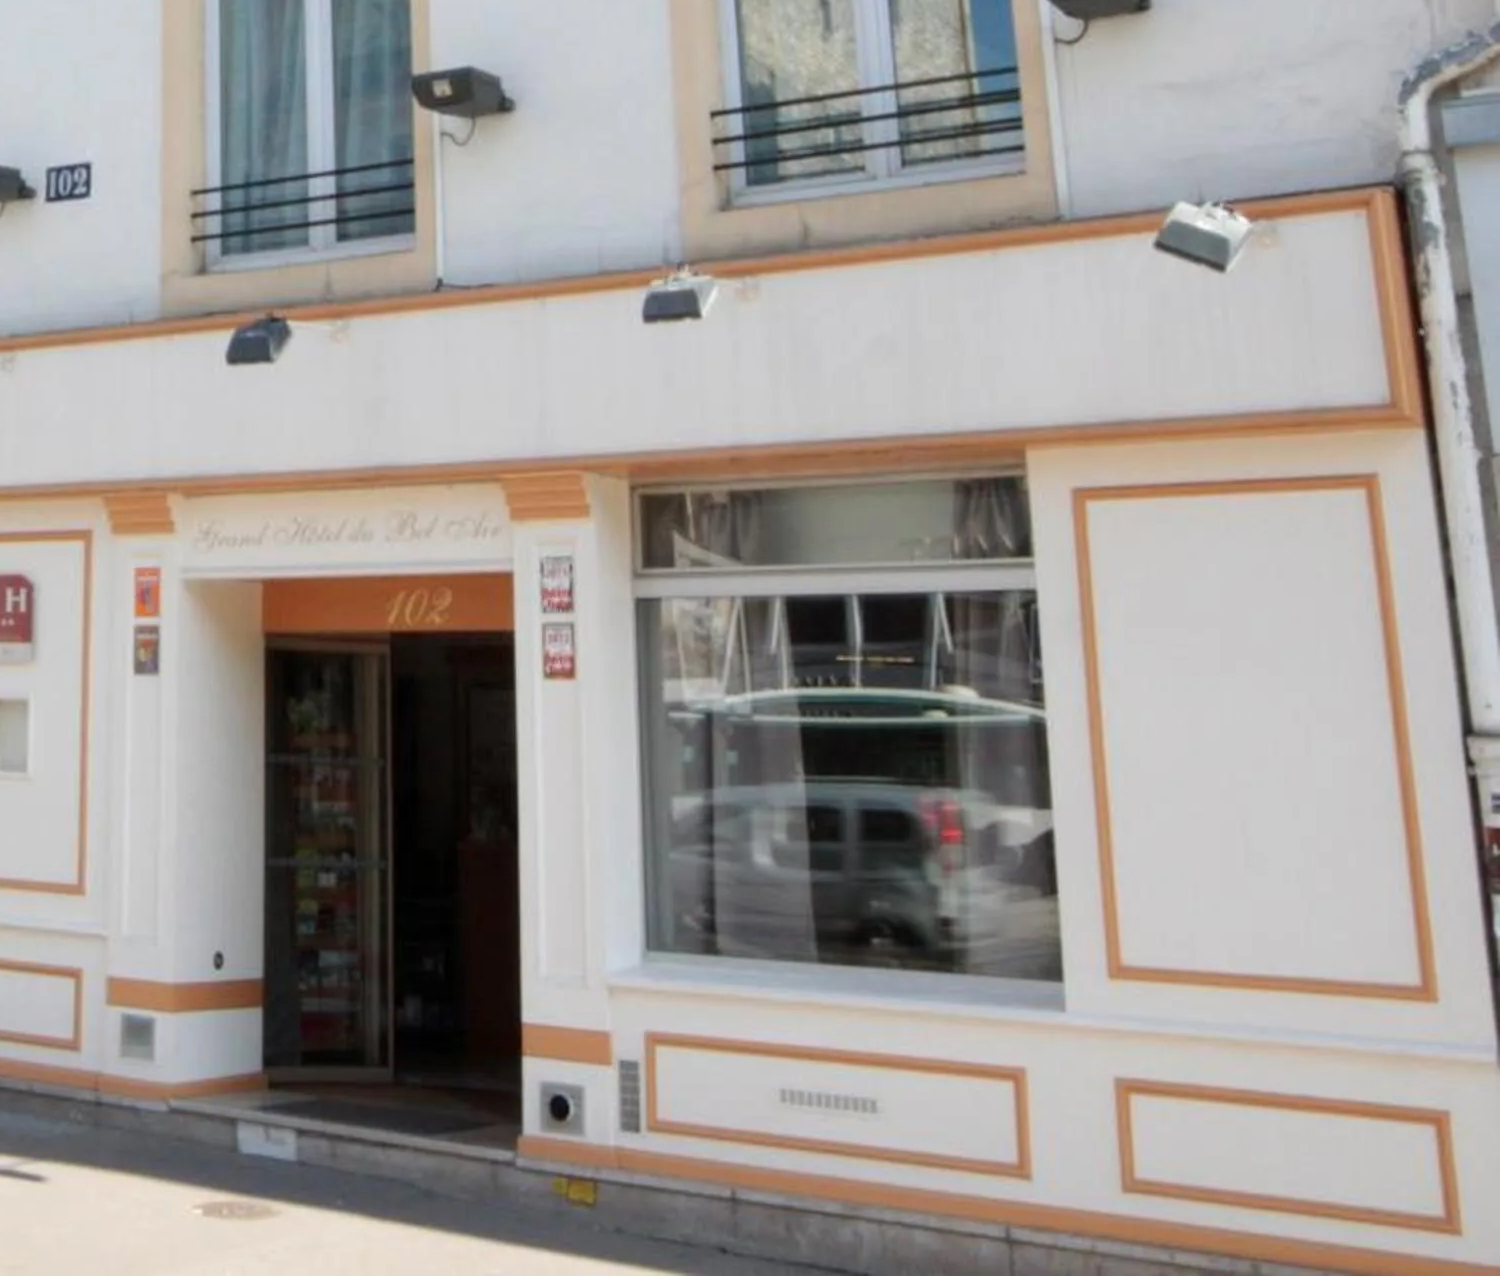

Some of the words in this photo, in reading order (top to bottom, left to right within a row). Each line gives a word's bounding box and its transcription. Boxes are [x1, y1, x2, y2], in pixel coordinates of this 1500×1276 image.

[49, 167, 88, 198] 102
[193, 520, 268, 552] Grand
[384, 510, 435, 545] Bel
[5, 585, 28, 613] H
[385, 586, 453, 626] 102
